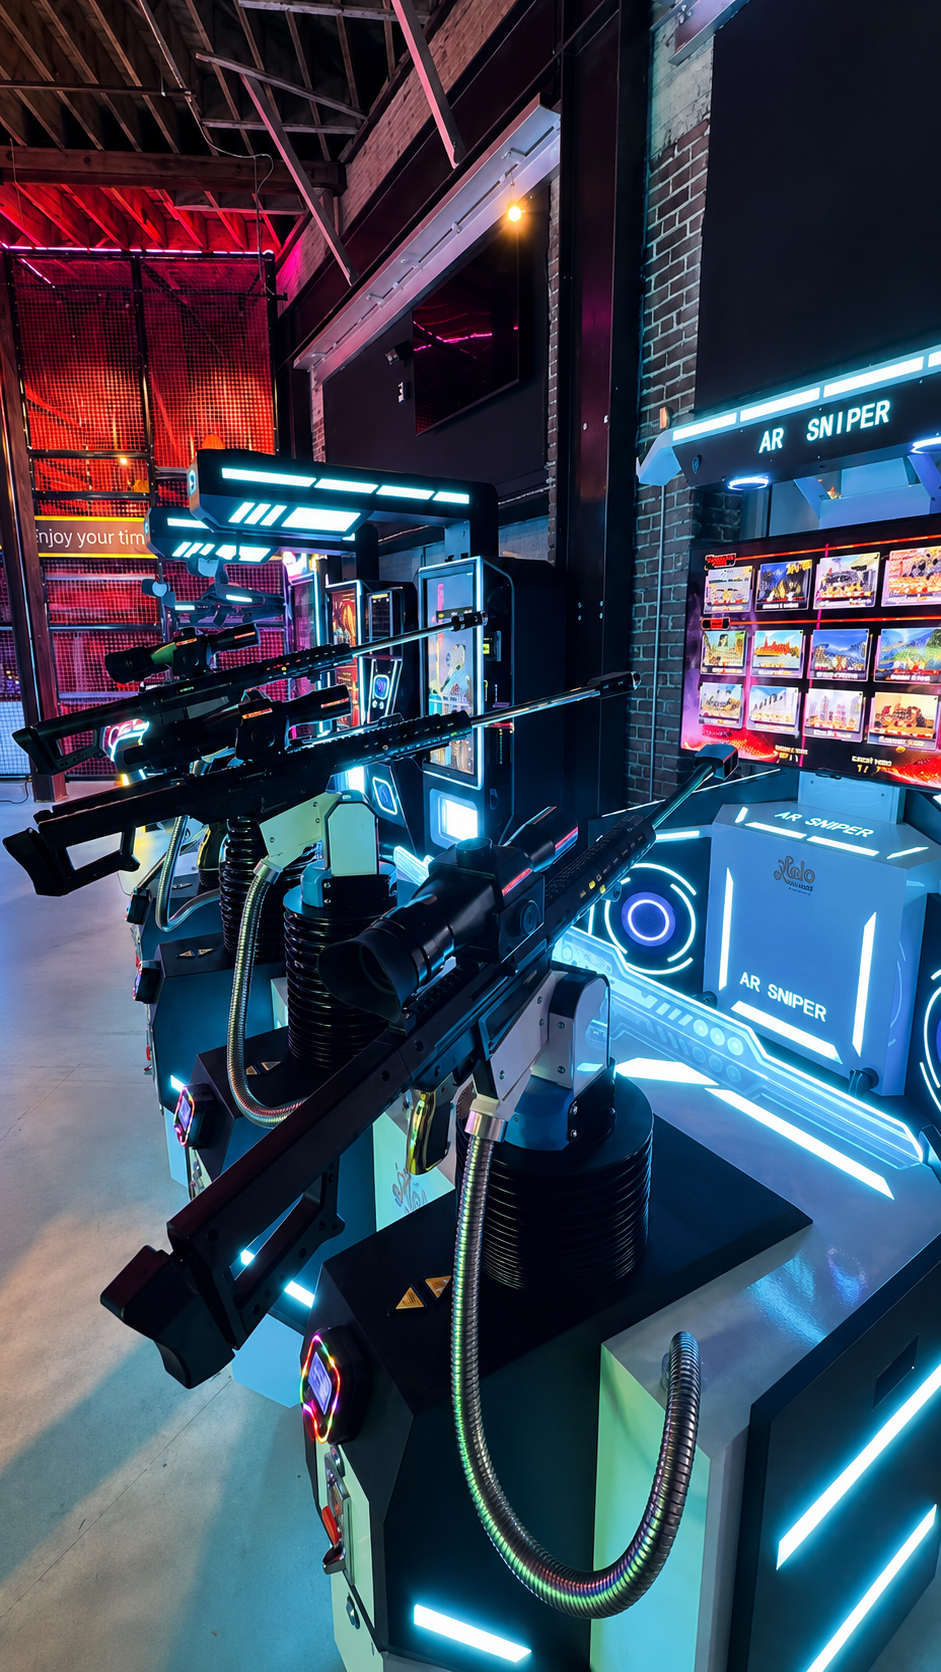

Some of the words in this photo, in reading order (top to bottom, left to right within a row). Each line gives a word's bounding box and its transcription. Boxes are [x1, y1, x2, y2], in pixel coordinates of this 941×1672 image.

[758, 427, 784, 454] AR
[806, 400, 891, 442] SNIPER
[77, 532, 115, 548] your
[774, 811, 802, 823] AR
[805, 817, 874, 838] SNIPER
[739, 971, 761, 993] AR
[767, 983, 827, 1022] SNIPER
